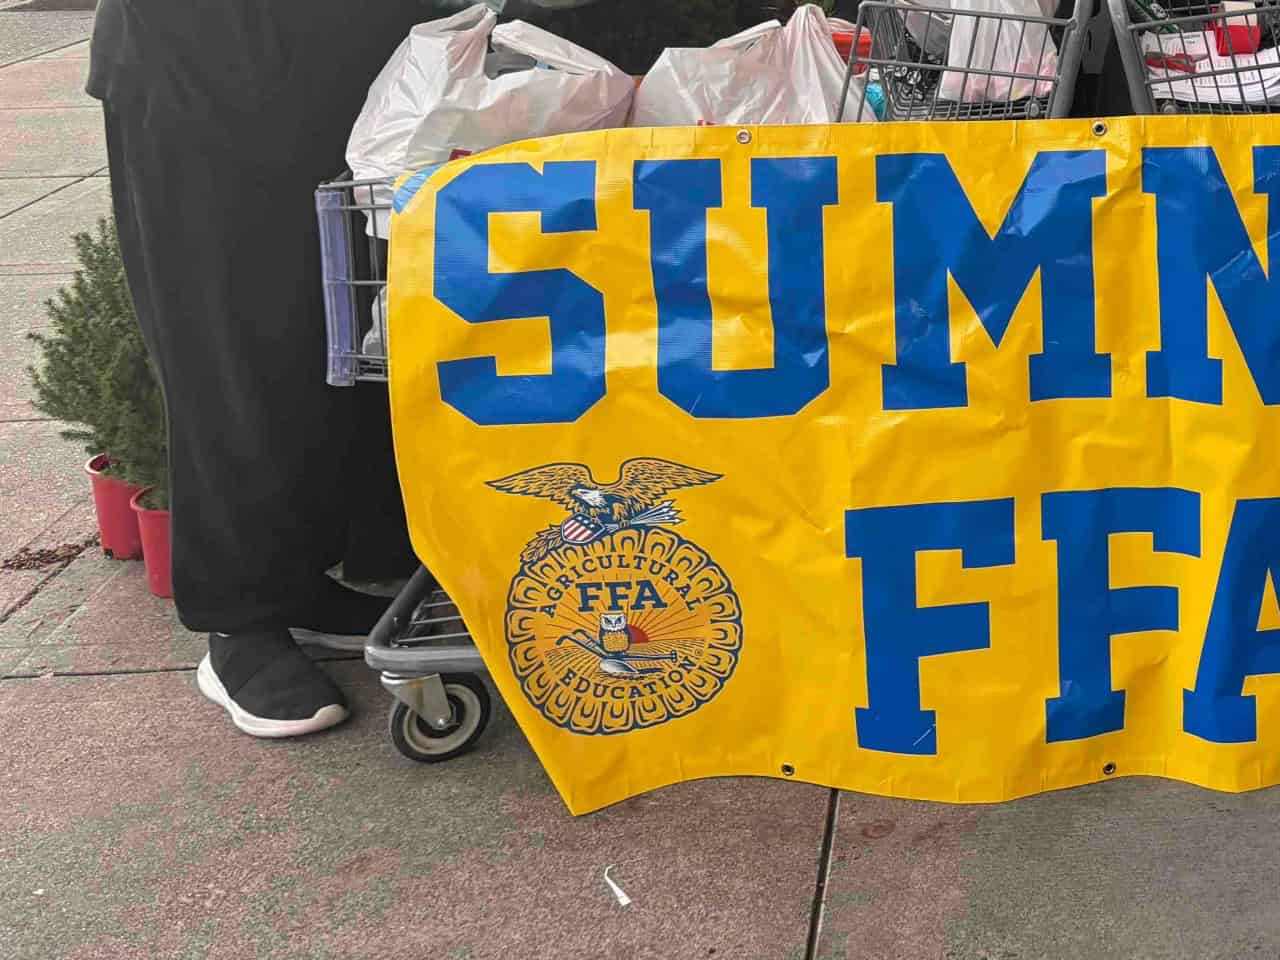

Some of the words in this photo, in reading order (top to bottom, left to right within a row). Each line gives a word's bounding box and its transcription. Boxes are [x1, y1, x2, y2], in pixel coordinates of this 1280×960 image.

[537, 553, 702, 618] AGRICULTURAL
[575, 580, 667, 612] FFA
[558, 655, 697, 700] EDUCATION
